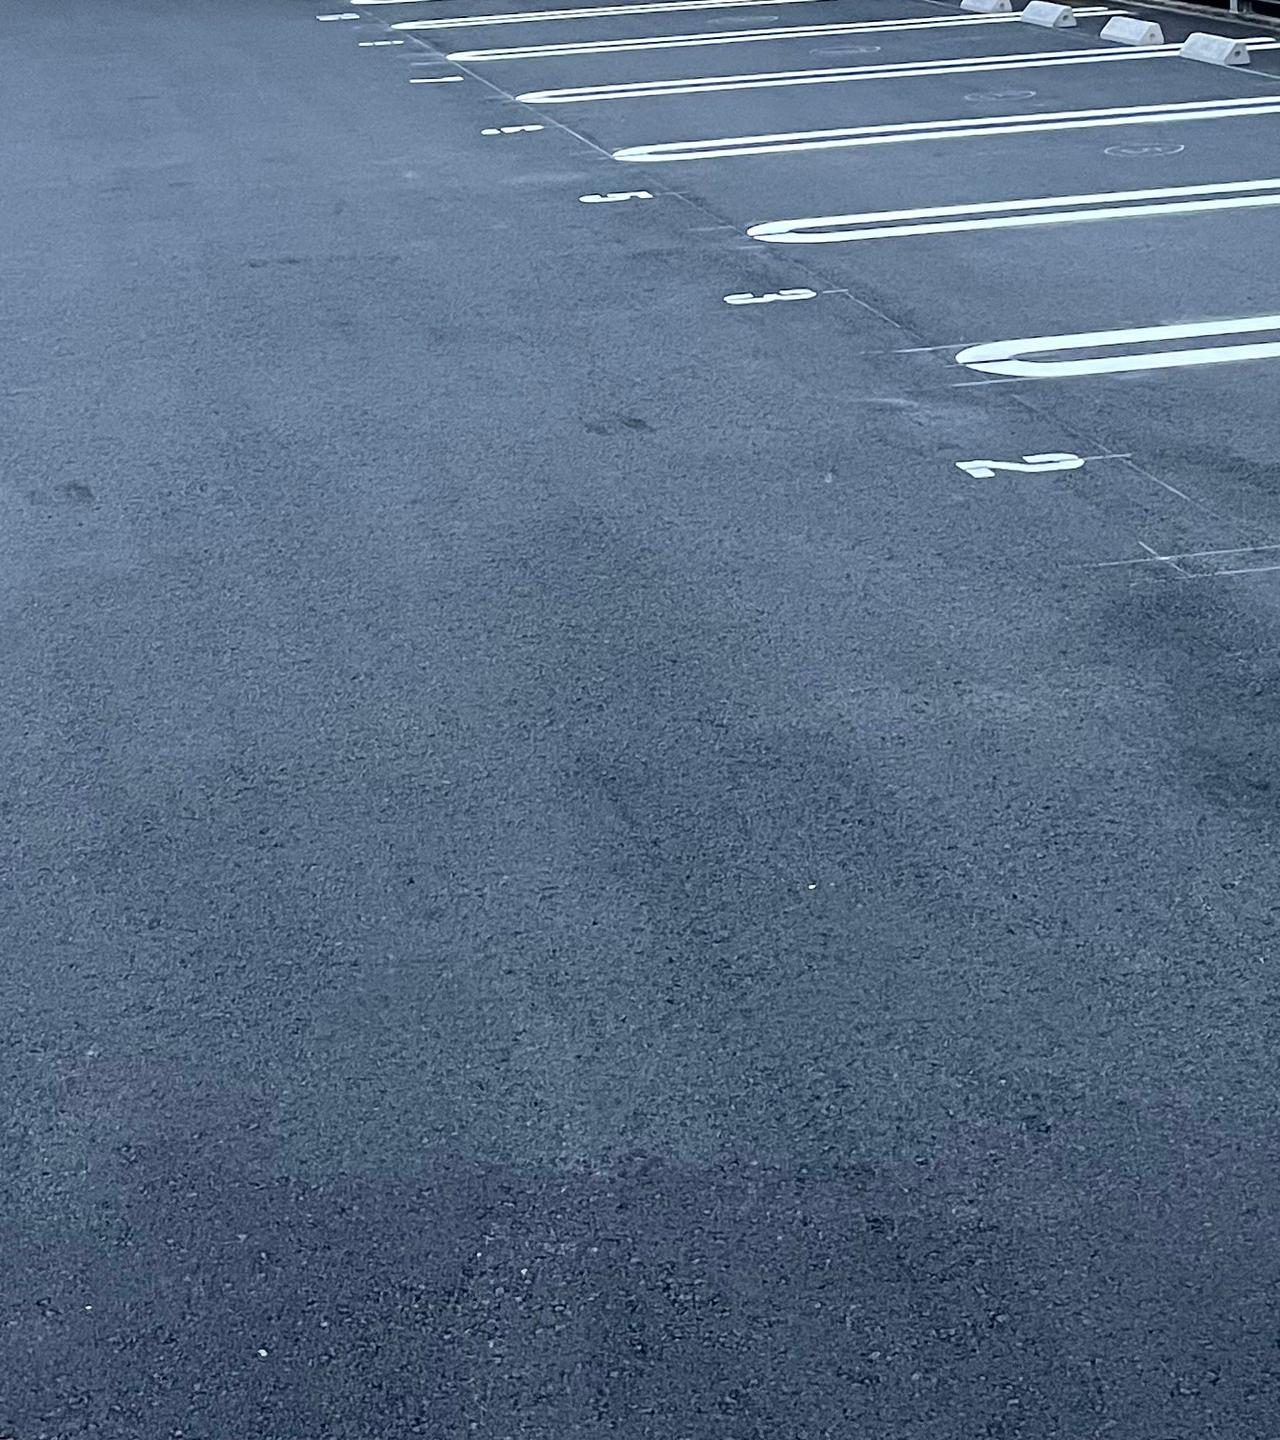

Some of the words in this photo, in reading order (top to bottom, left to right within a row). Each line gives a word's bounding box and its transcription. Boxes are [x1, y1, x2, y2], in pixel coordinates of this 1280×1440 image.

[578, 190, 654, 203] 5
[723, 288, 818, 305] 3
[955, 452, 1087, 479] 2
